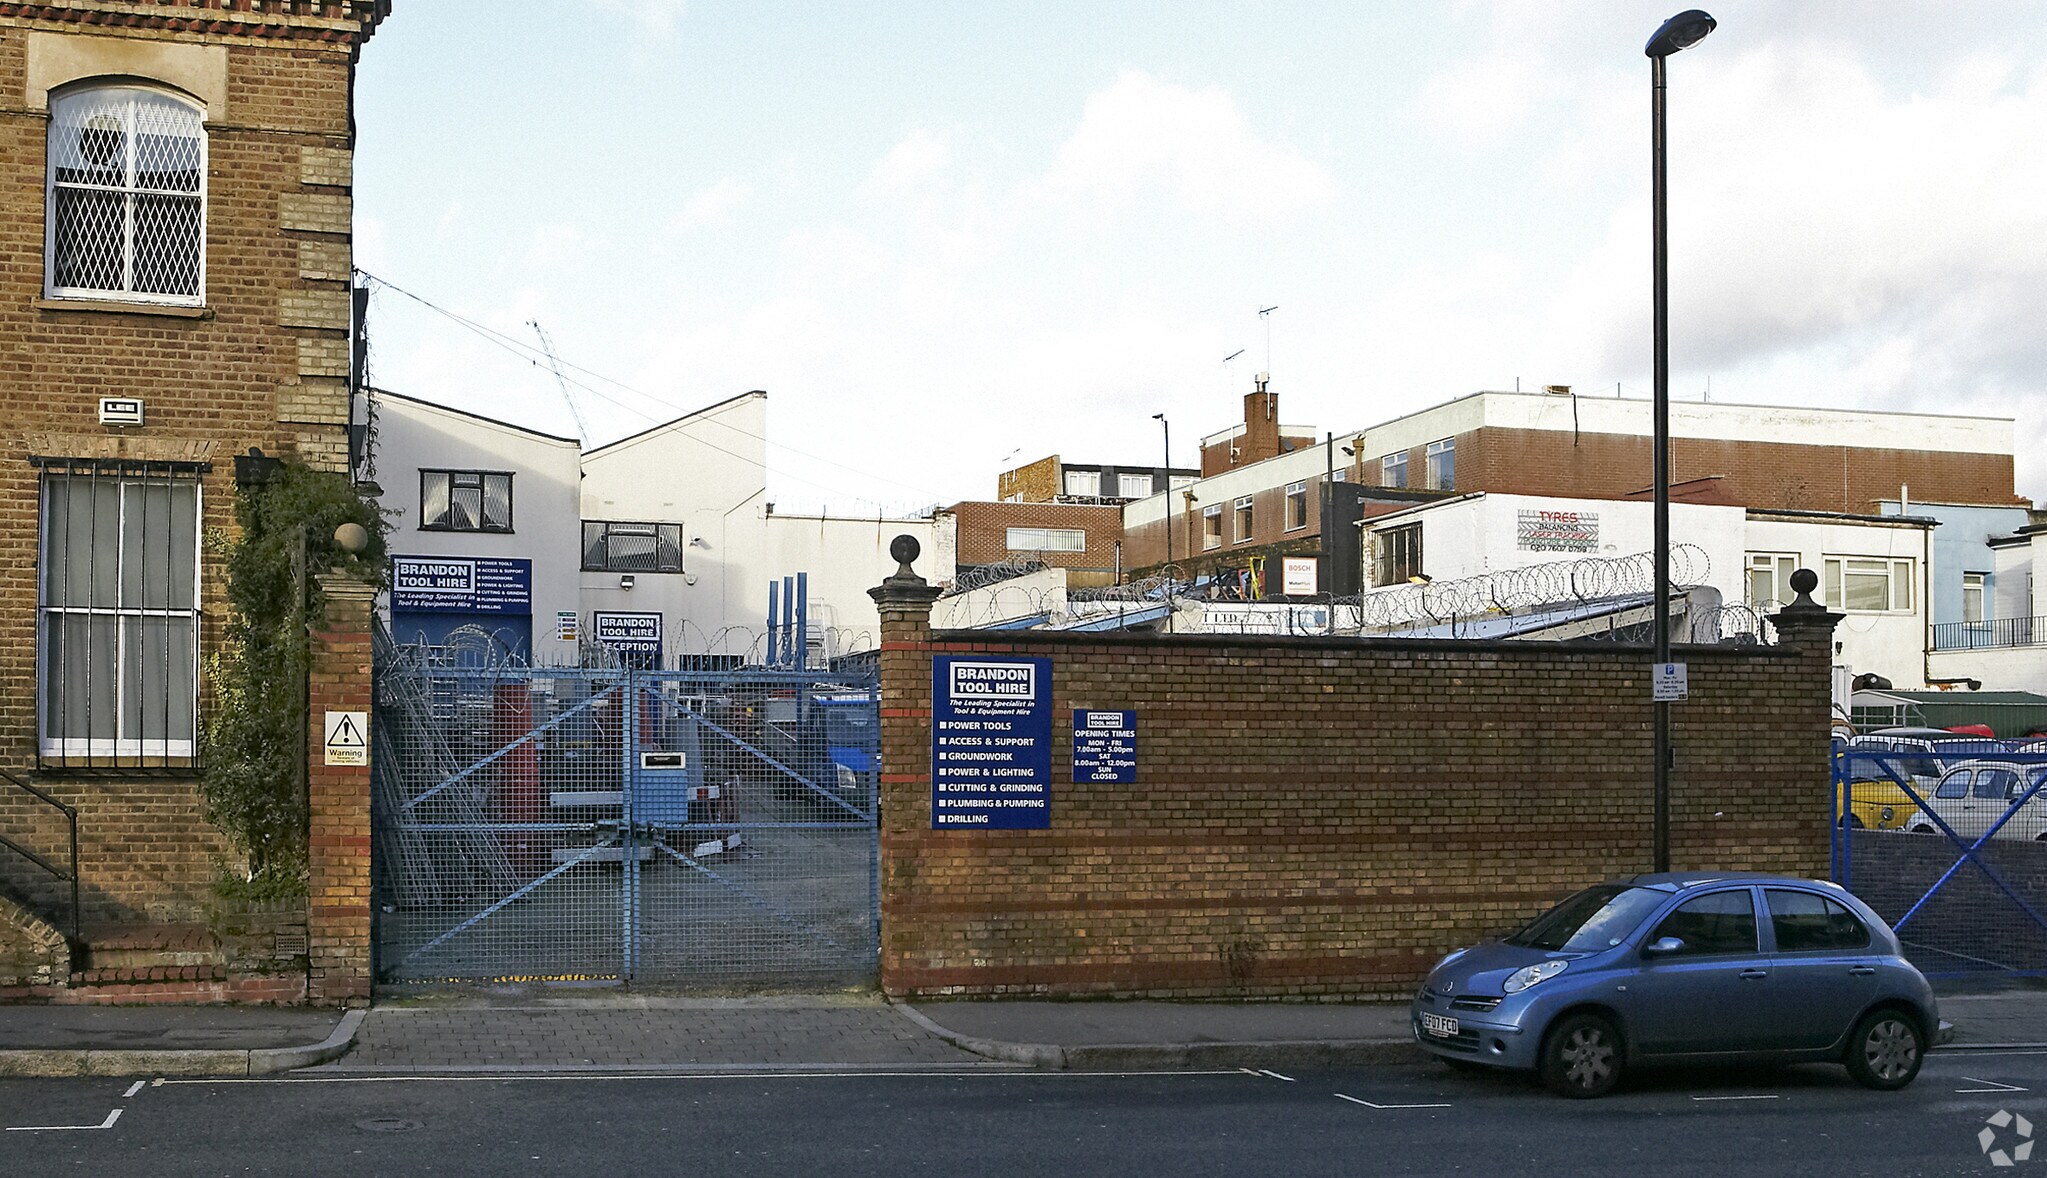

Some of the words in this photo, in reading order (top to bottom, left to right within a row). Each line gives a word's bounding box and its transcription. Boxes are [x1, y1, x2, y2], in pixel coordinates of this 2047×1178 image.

[1540, 511, 1578, 523] TYRES
[1540, 524, 1578, 532] BALANCING
[1530, 544, 1546, 552] 020
[400, 564, 468, 576] BRANDON
[400, 577, 434, 587] TOOL
[437, 578, 468, 588] HIRE
[602, 618, 654, 628] BRANDON
[602, 628, 628, 636] TOOL
[630, 628, 654, 636] HIRE
[957, 668, 1028, 680] BRANDON
[957, 682, 992, 693] TOOL
[996, 682, 1028, 694] HIRE
[964, 700, 992, 708] Leading
[948, 722, 980, 730] POWER
[983, 722, 1012, 730] TOOLS
[948, 738, 982, 746] ACCESS
[985, 738, 992, 746] &
[995, 738, 1034, 746] SUPPORT
[330, 750, 362, 758] Warning
[948, 752, 1013, 760] GROUNDWORK
[948, 768, 980, 776] POWER
[992, 768, 1034, 776] LIGHTING
[948, 784, 986, 792] CUTTING
[990, 784, 996, 792] &
[1000, 784, 1042, 792] GRINDING
[948, 800, 994, 808] PLUMBING
[948, 815, 988, 823] DRILLING
[1425, 1014, 1440, 1028] EF07
[1442, 1018, 1457, 1032] FCD
